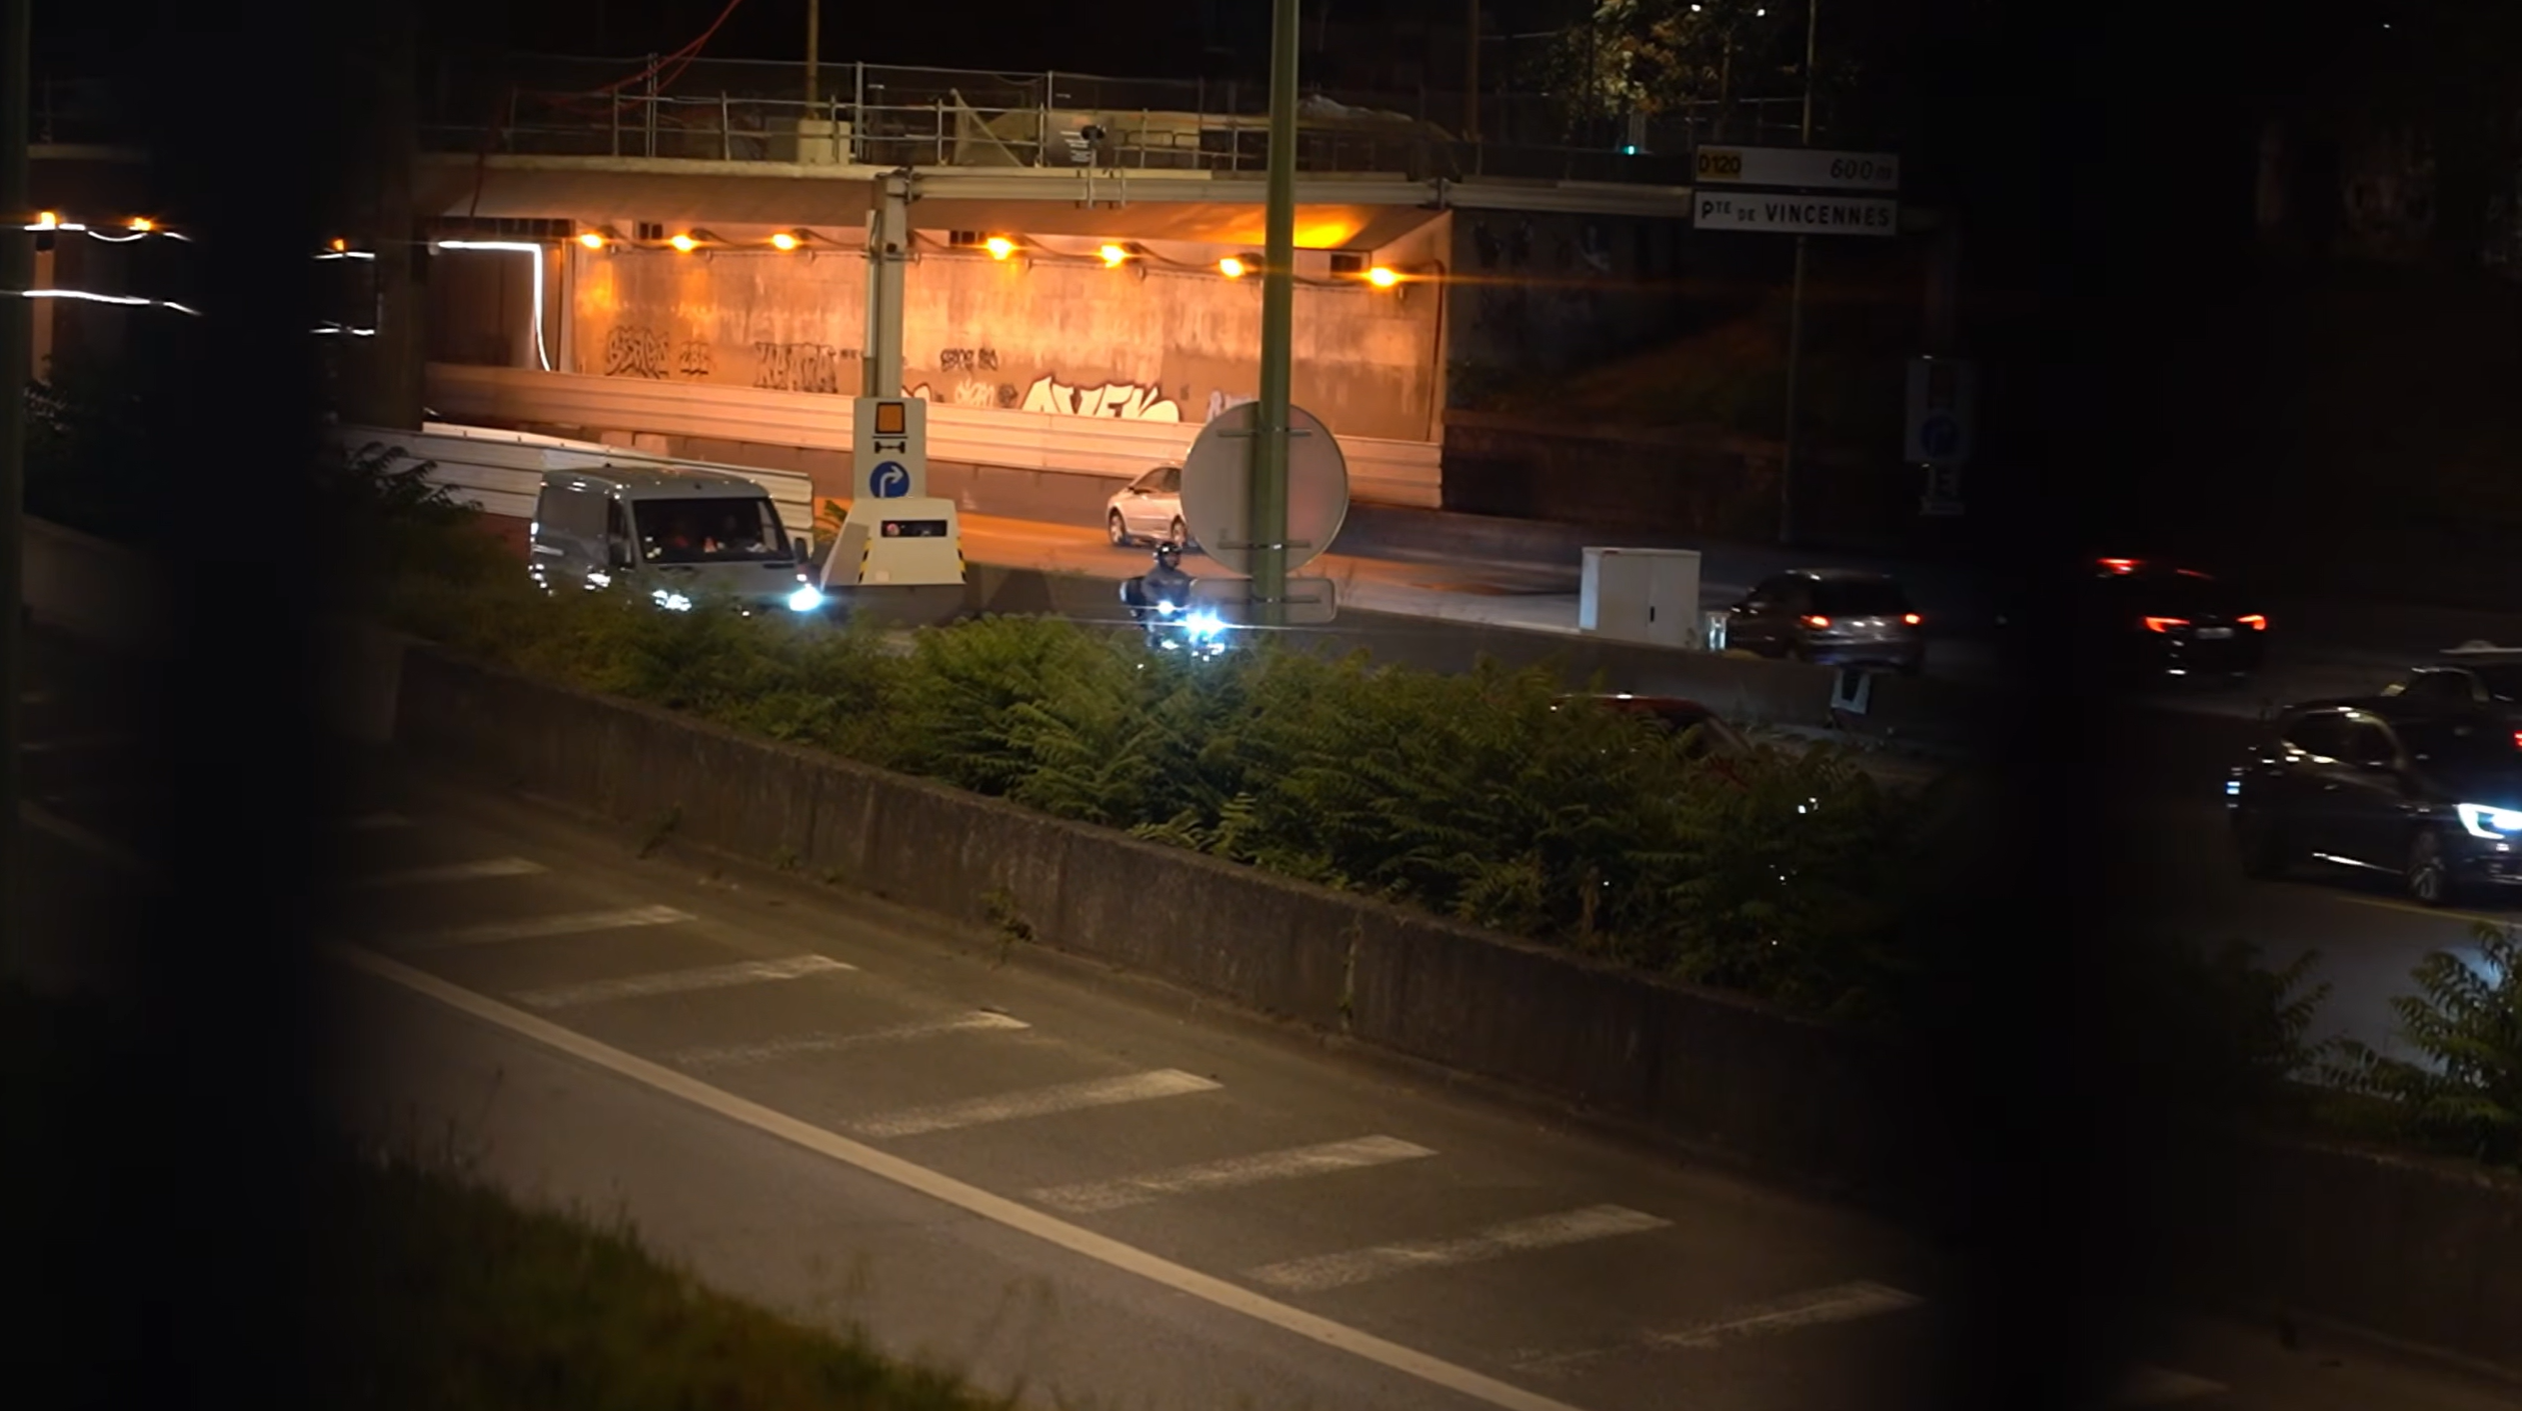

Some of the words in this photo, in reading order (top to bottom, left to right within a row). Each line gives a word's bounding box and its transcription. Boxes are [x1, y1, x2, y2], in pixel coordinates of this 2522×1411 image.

[1698, 154, 1742, 174] D120
[1737, 208, 1756, 222] DE
[1765, 203, 1890, 227] VINCENNES
